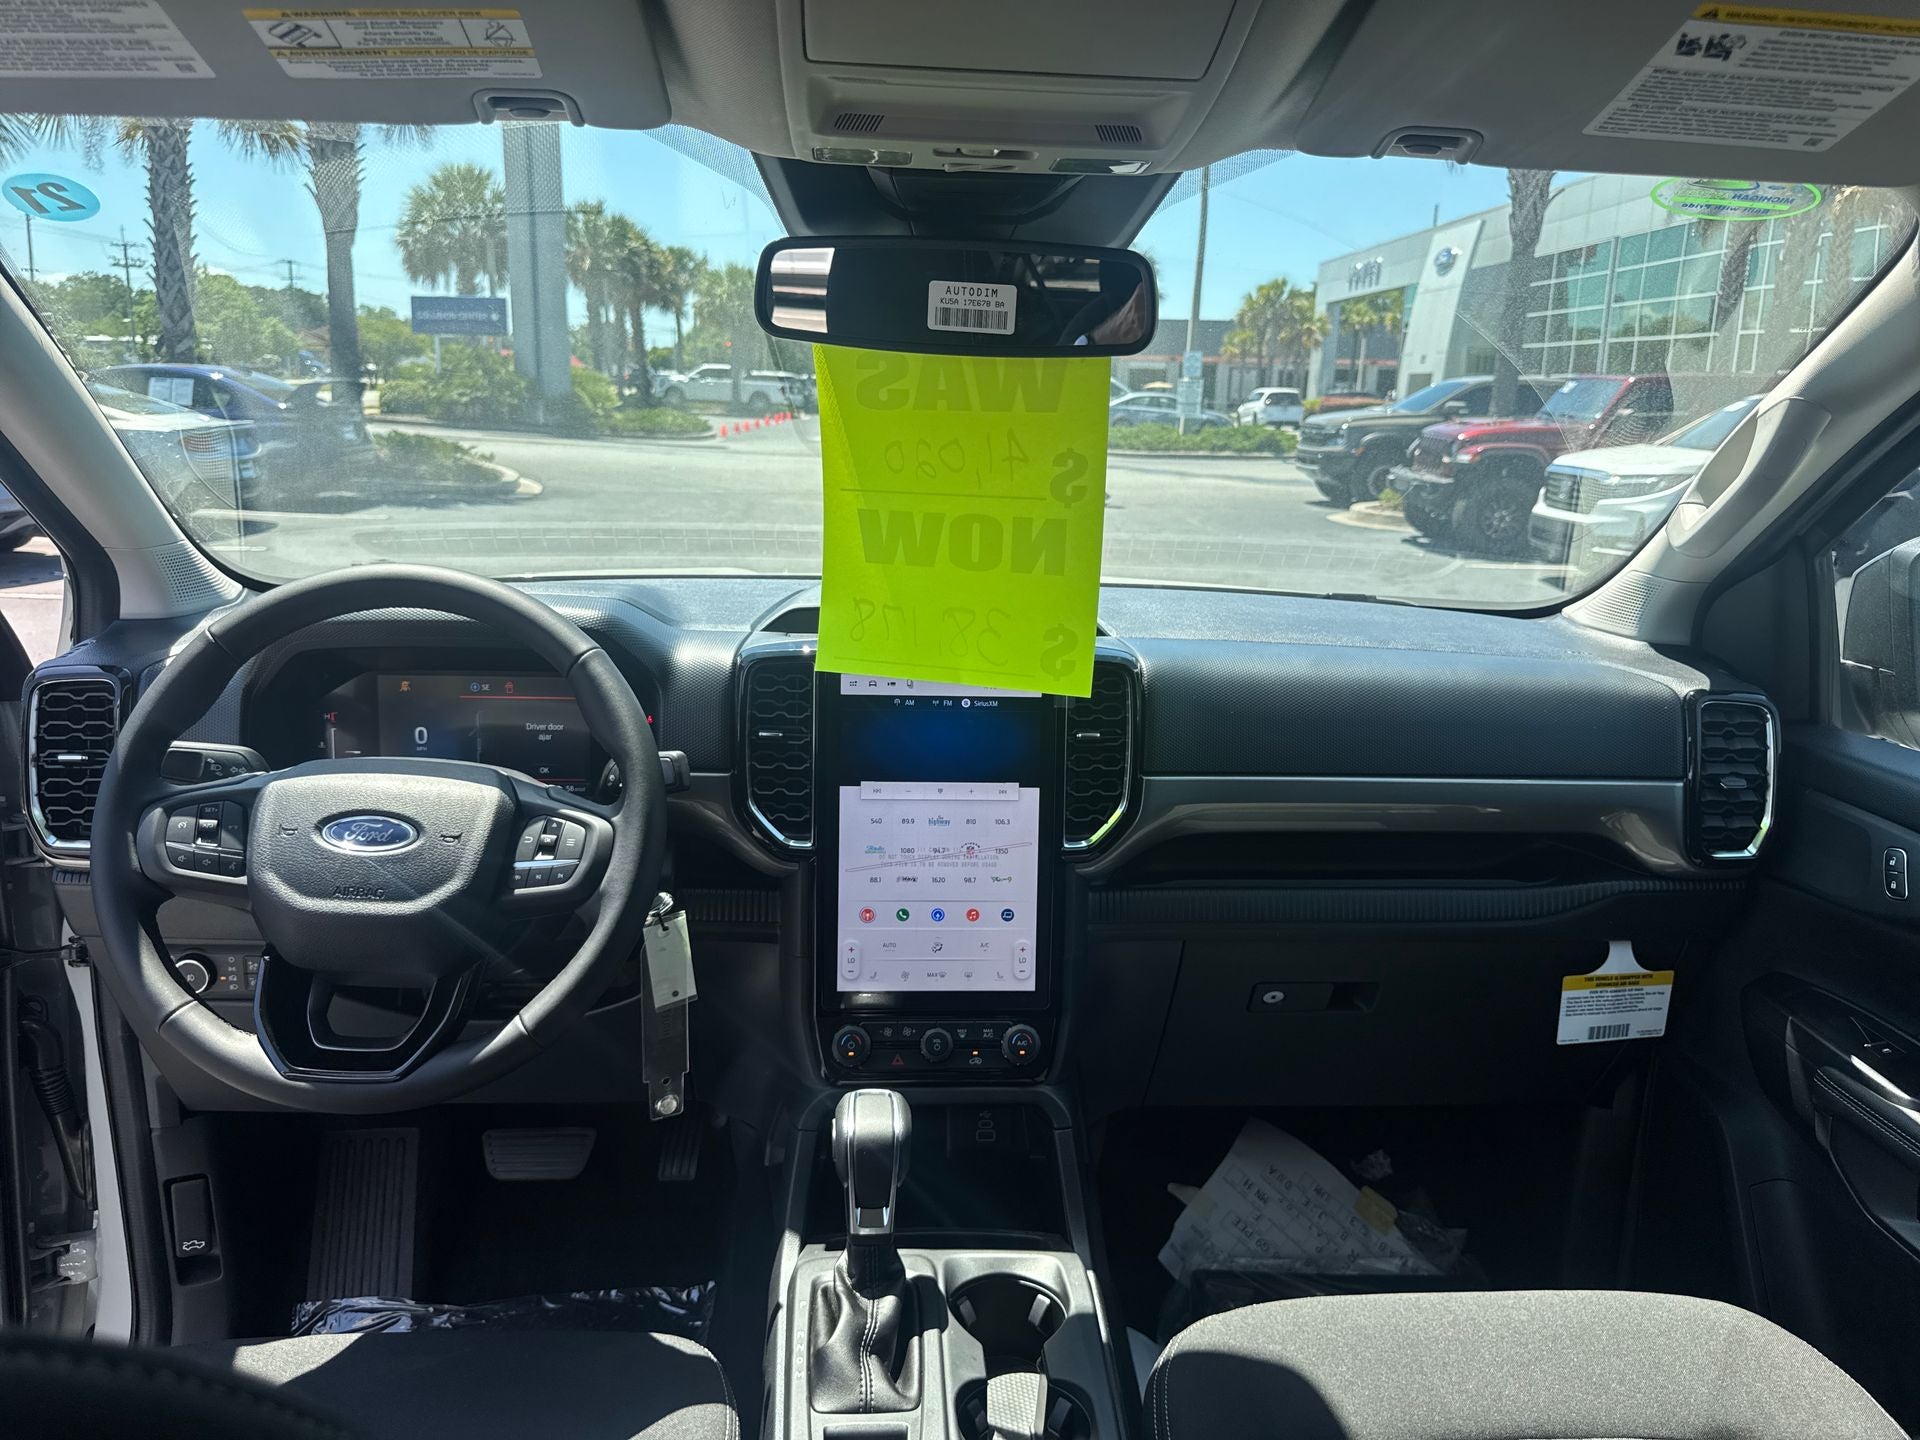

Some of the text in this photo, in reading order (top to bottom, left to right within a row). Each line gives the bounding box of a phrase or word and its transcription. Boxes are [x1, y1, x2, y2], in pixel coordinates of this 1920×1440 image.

[945, 286, 998, 298] AUTODIM
[525, 722, 564, 731] Driver door
[413, 726, 429, 745] 0
[538, 733, 553, 742] ajar
[343, 822, 394, 842] Ford
[333, 885, 385, 899] AIRBAG
